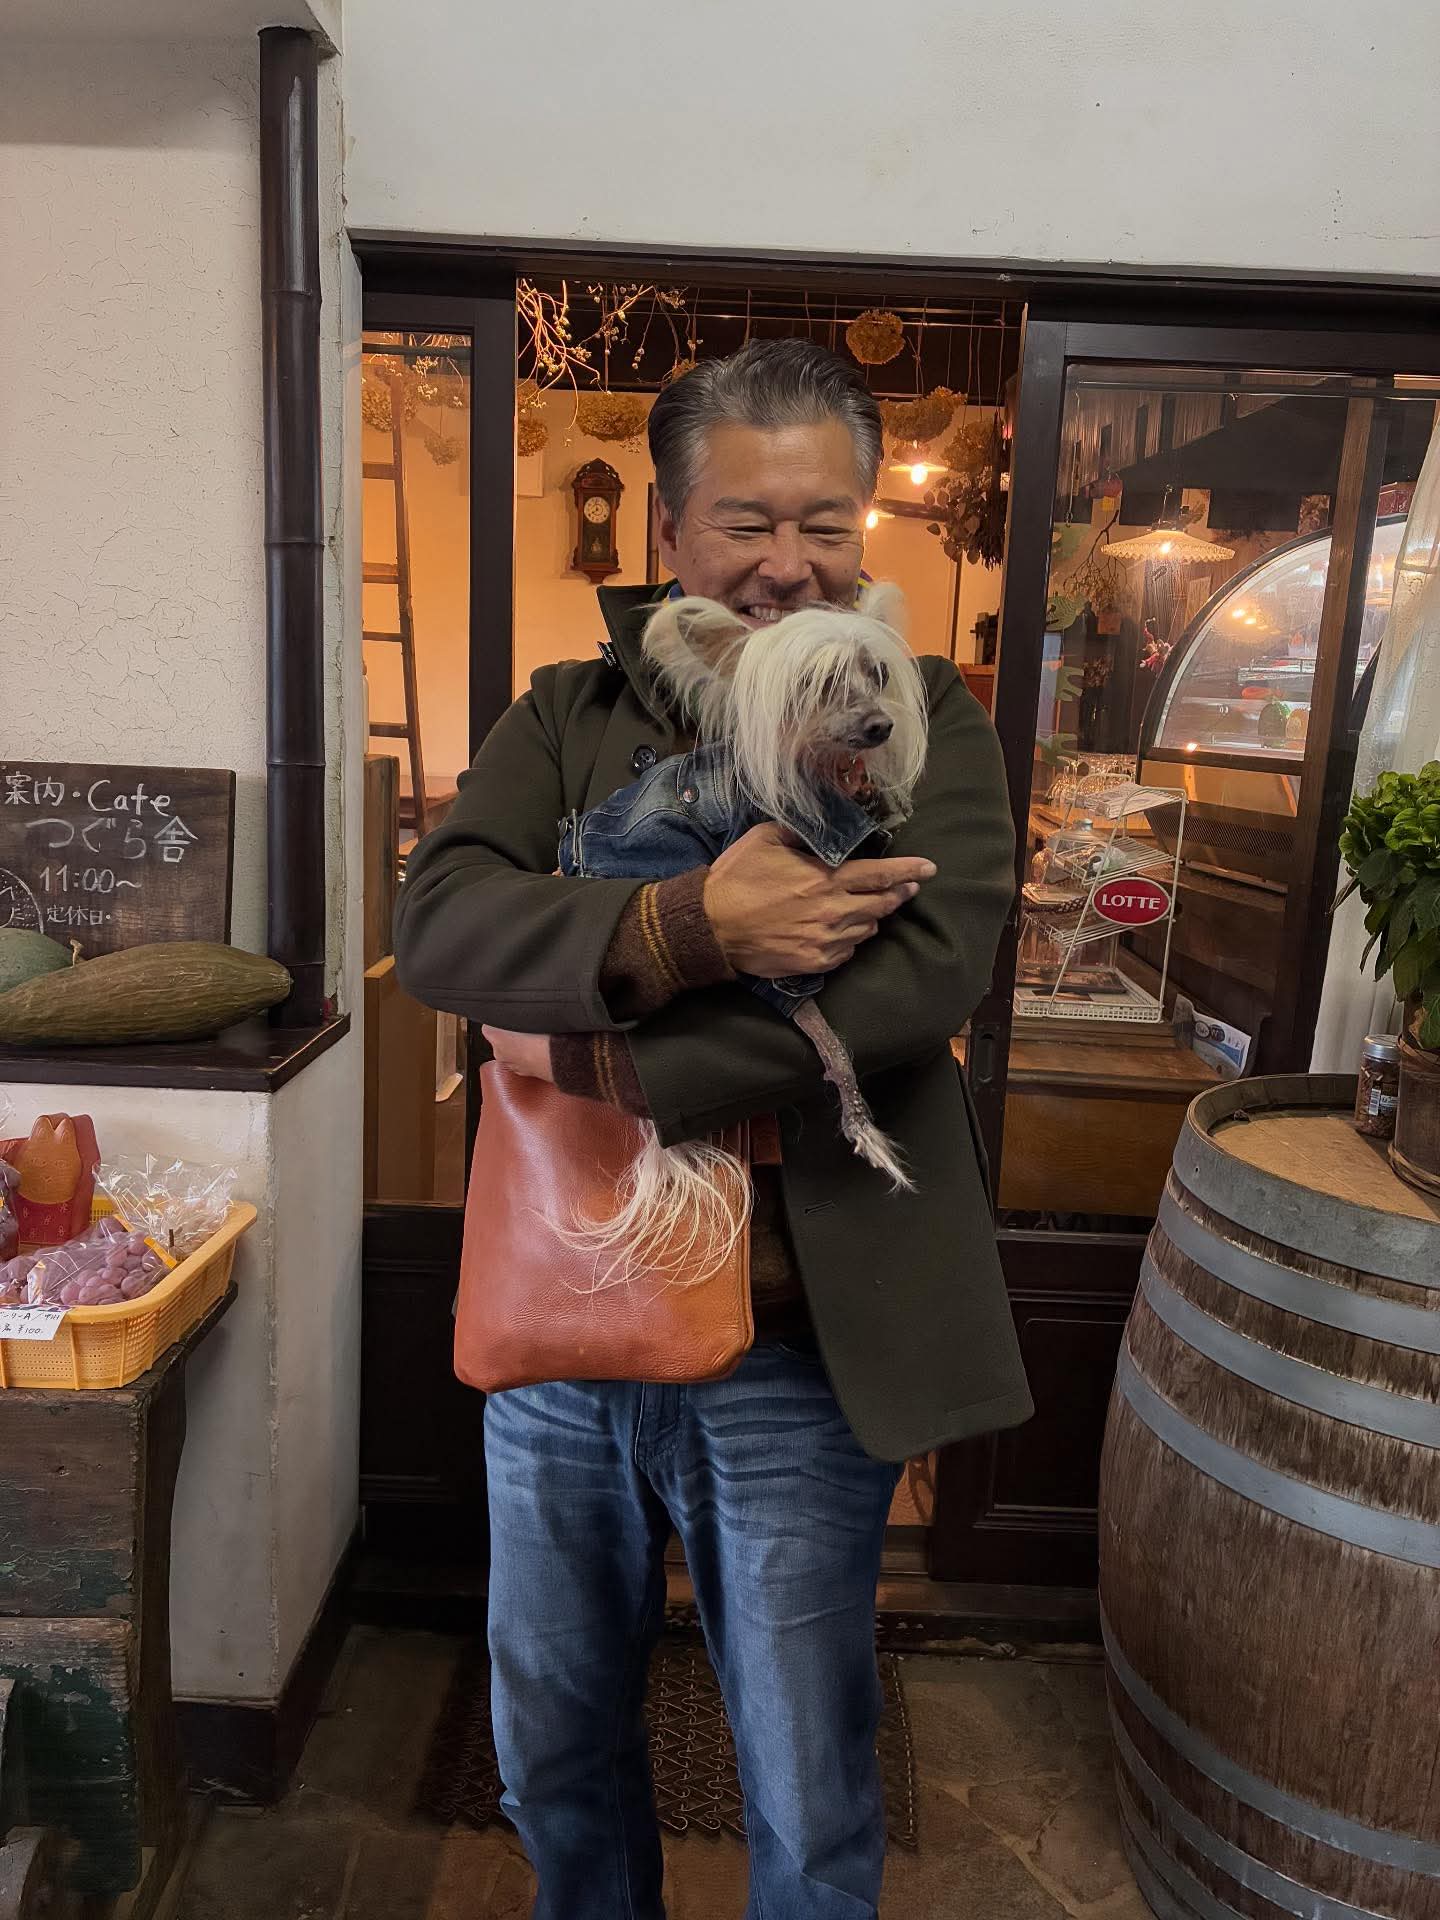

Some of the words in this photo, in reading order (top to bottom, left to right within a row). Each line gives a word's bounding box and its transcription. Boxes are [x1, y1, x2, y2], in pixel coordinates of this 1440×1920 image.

[26, 816, 198, 863] つぐら舎
[1102, 895, 1161, 910] LOTTE
